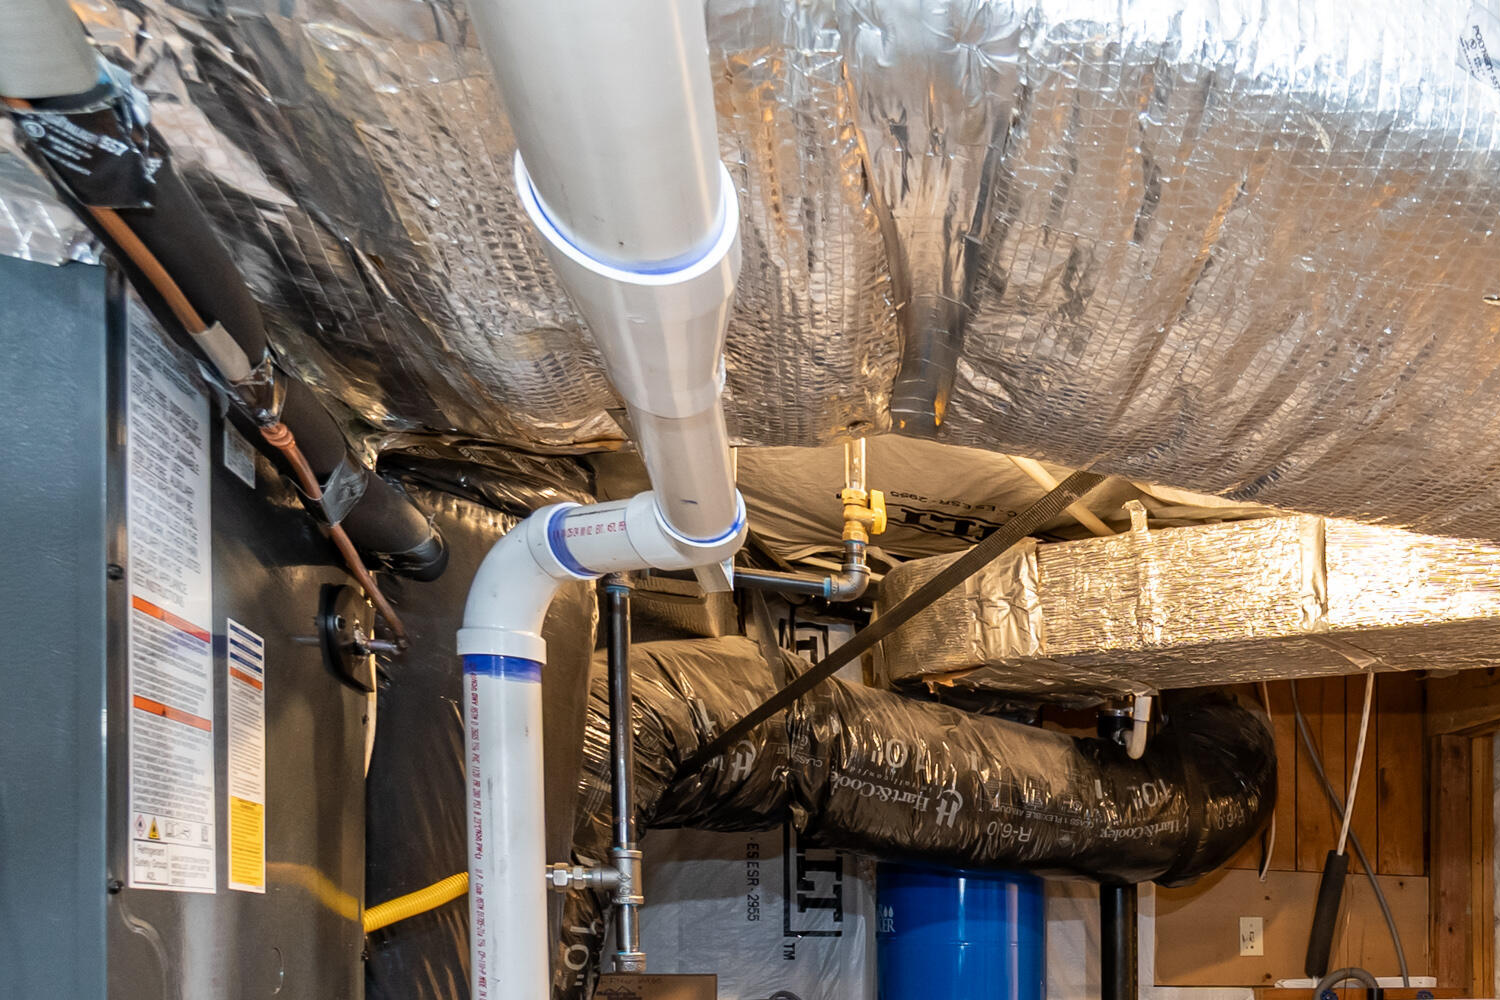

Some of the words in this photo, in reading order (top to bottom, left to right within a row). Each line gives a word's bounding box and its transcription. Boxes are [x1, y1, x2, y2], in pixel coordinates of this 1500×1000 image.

[830, 770, 930, 813] Hart&Coole
[1026, 811, 1063, 824] FLEXIBLE
[987, 821, 1033, 843] R-6.0
[746, 843, 760, 860] ES
[746, 861, 760, 888] ESR
[747, 894, 760, 922] 2955
